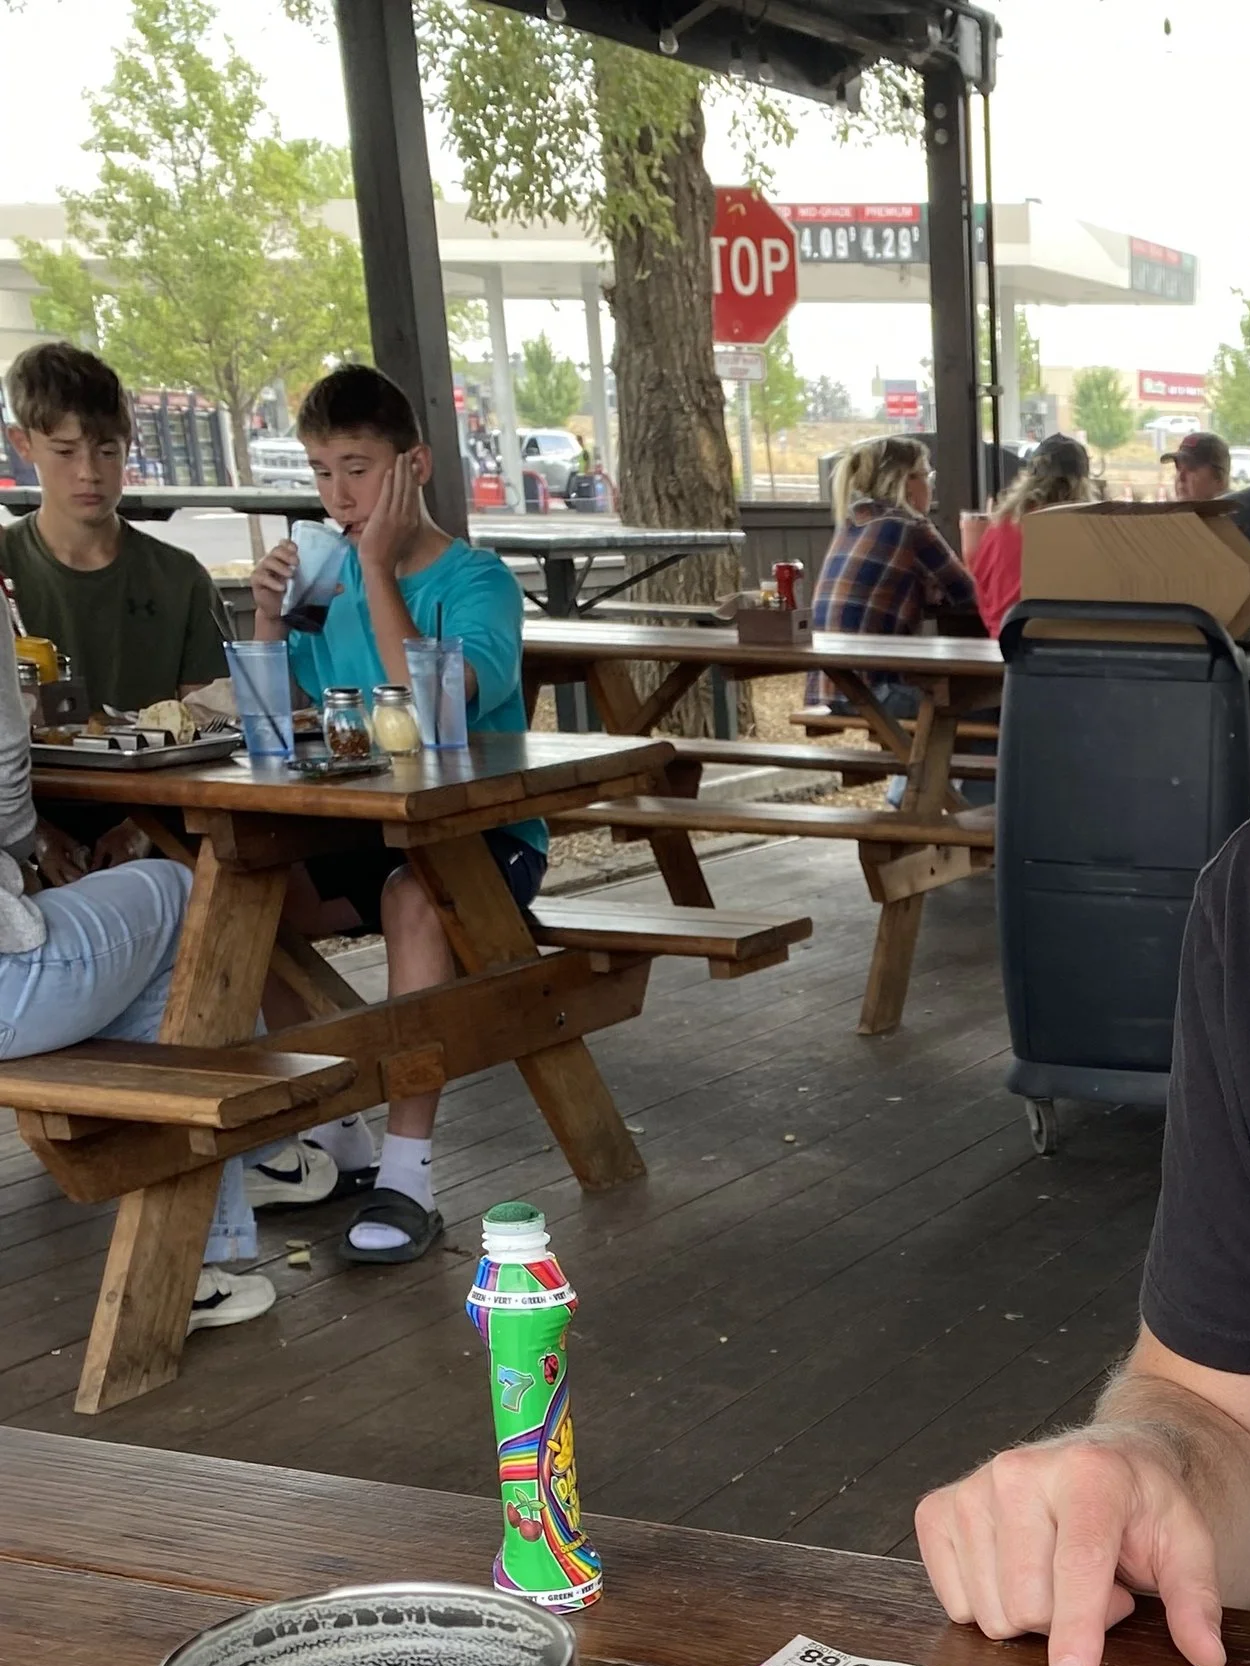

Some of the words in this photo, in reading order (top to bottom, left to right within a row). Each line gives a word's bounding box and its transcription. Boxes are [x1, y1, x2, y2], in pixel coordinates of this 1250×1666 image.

[864, 205, 913, 217] PREMIUM
[711, 236, 789, 296] TOP
[547, 1592, 574, 1602] GREEN
